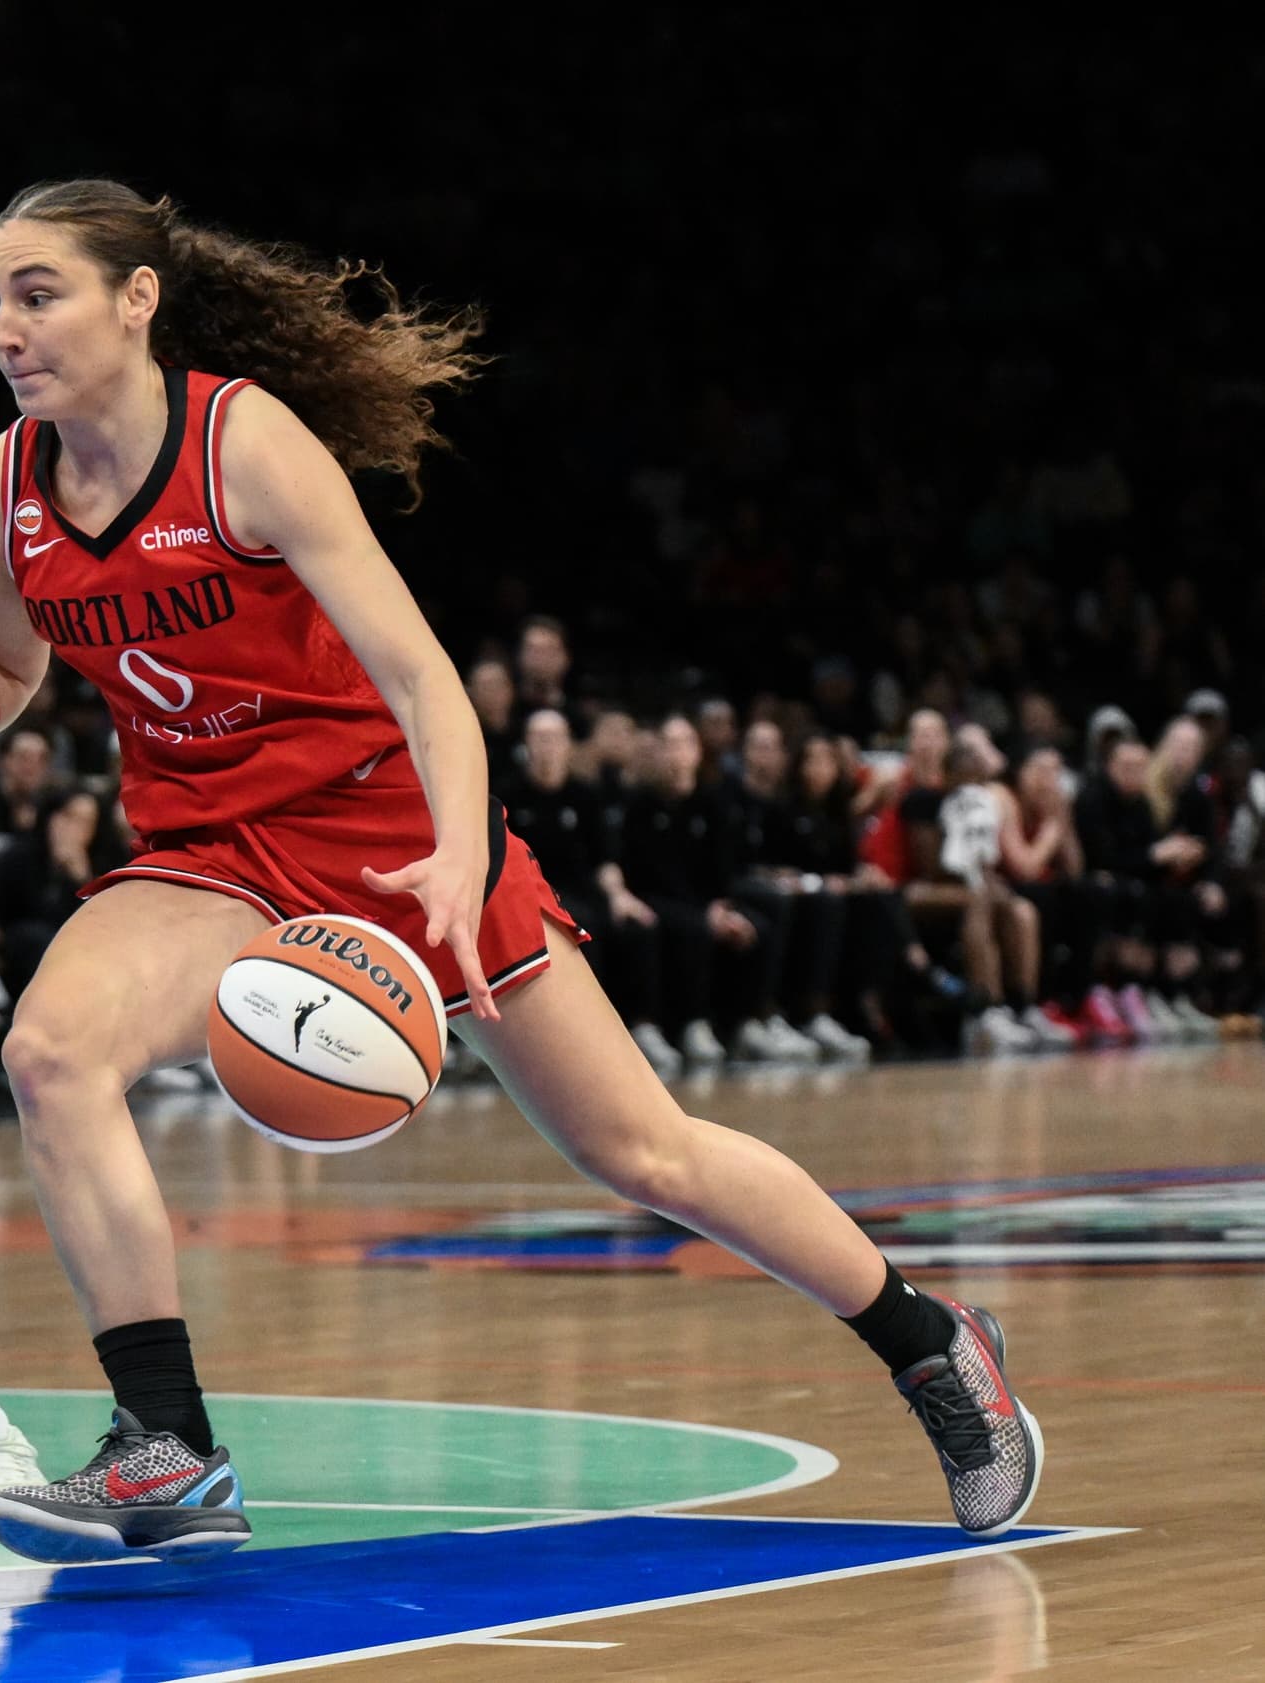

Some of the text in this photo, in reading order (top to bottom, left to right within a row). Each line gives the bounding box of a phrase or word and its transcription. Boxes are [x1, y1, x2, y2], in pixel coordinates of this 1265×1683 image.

[140, 523, 211, 551] chime
[24, 572, 236, 647] PORTLAND
[118, 648, 195, 713] 0
[277, 924, 414, 1016] Wilson
